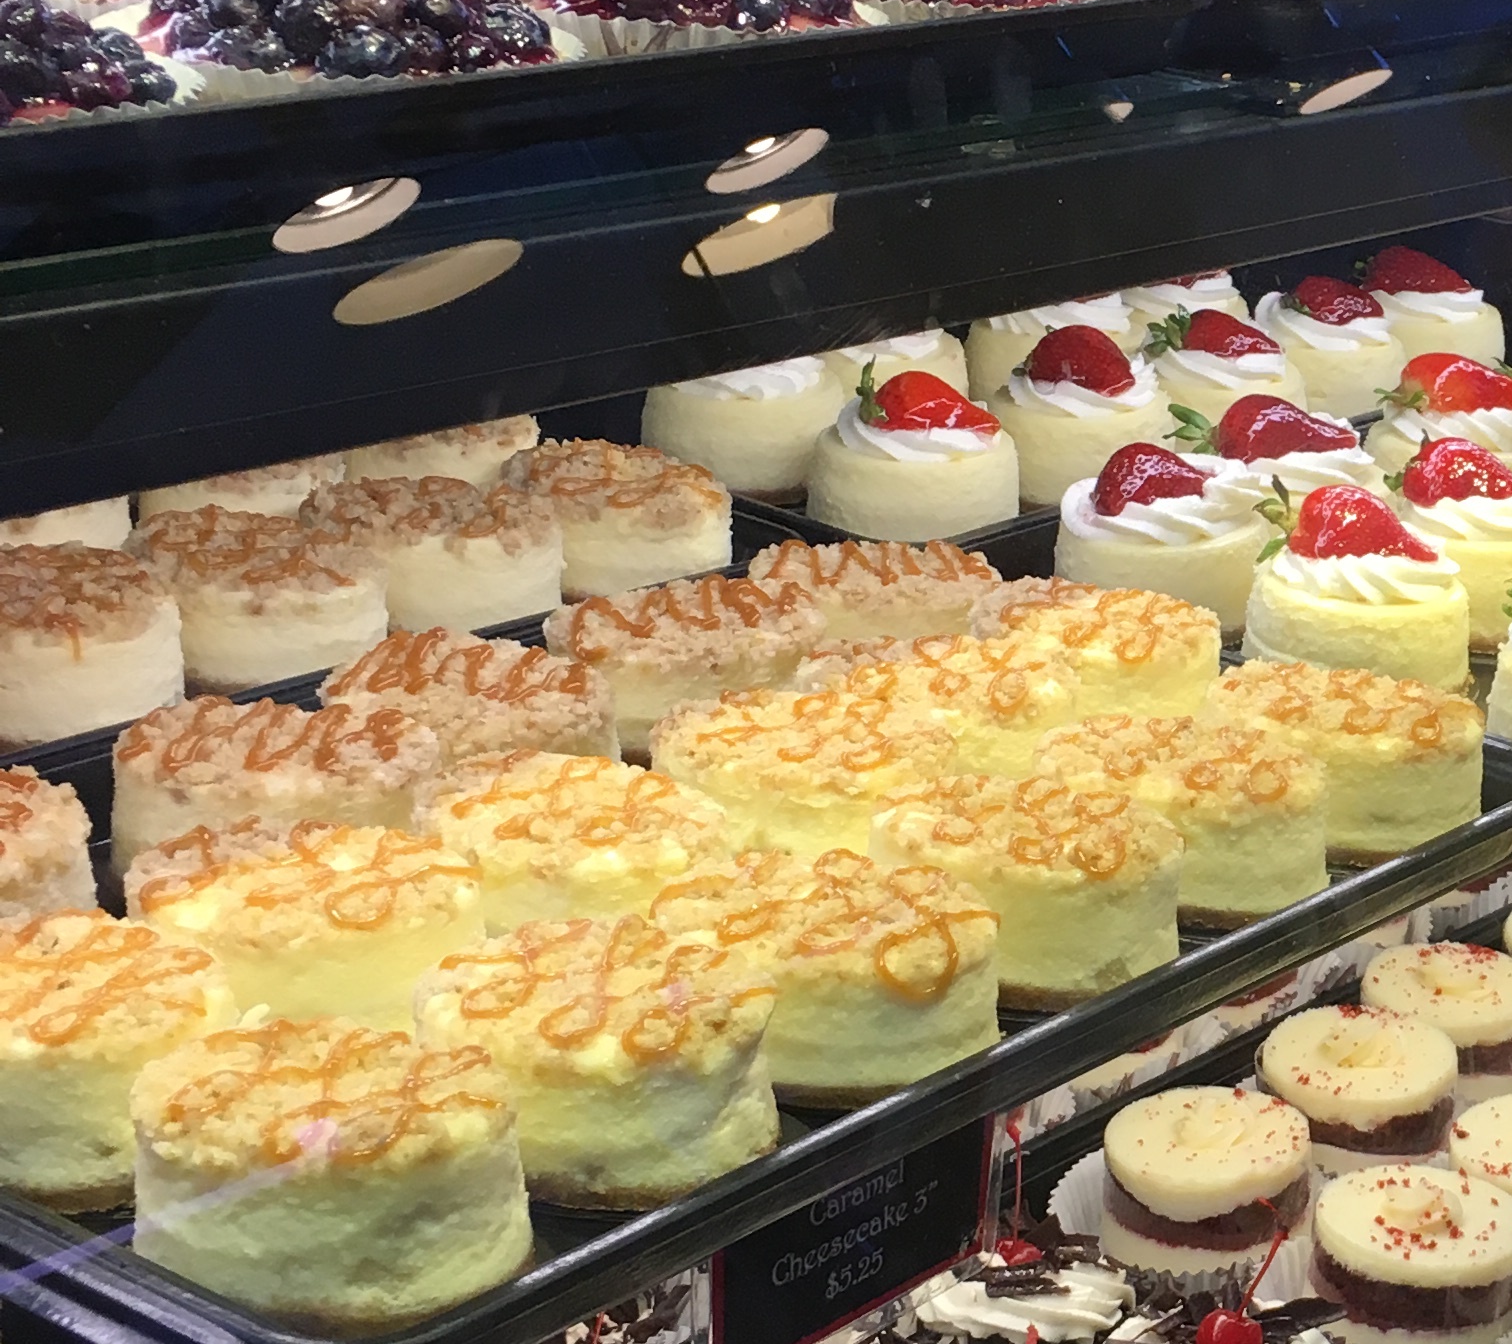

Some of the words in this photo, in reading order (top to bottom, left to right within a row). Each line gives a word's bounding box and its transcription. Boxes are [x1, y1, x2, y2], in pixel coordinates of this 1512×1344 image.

[808, 1156, 905, 1227] Caramel
[771, 1202, 909, 1287] Cheesecake
[824, 1246, 886, 1300] $5.25
